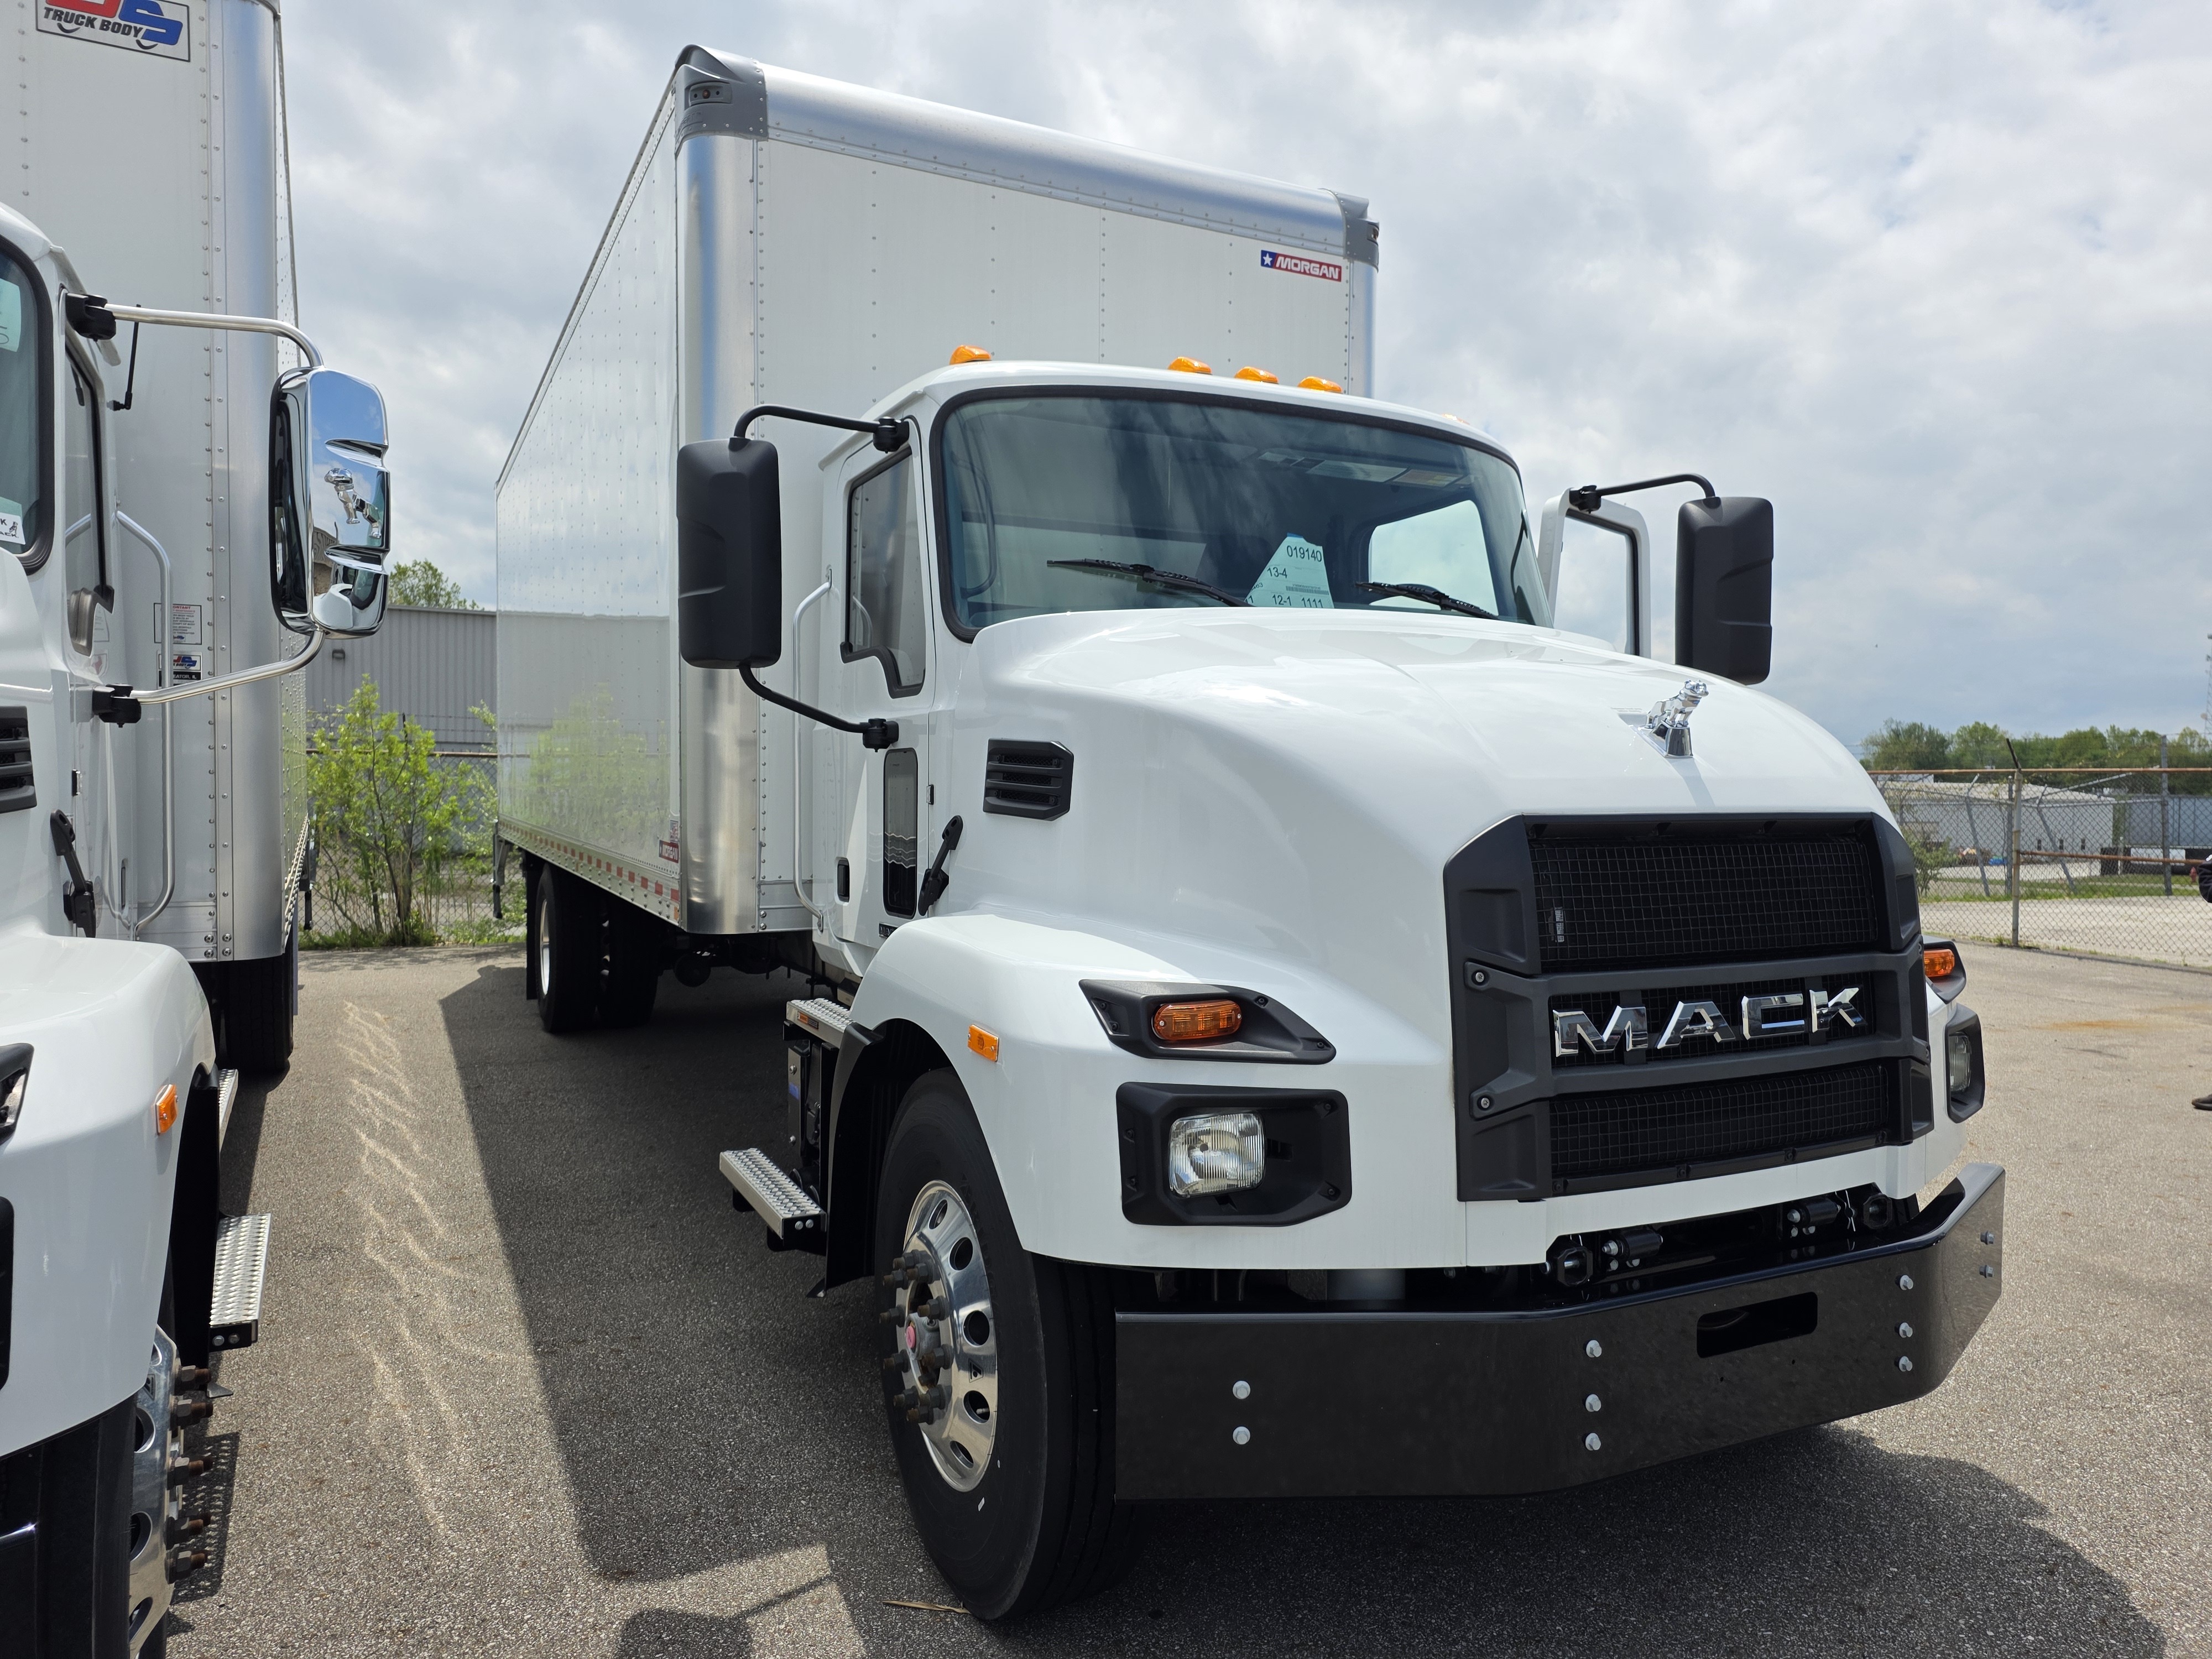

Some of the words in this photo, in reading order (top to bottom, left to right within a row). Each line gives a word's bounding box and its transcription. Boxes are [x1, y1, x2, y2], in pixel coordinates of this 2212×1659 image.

[43, 7, 97, 29] TRUCK
[99, 18, 143, 38] BODY
[1275, 256, 1339, 280] MORGAN
[1286, 545, 1322, 562] 019140
[1267, 567, 1287, 578] 13-4
[1272, 594, 1292, 606] 12-1
[1553, 988, 1868, 1057] MACK
